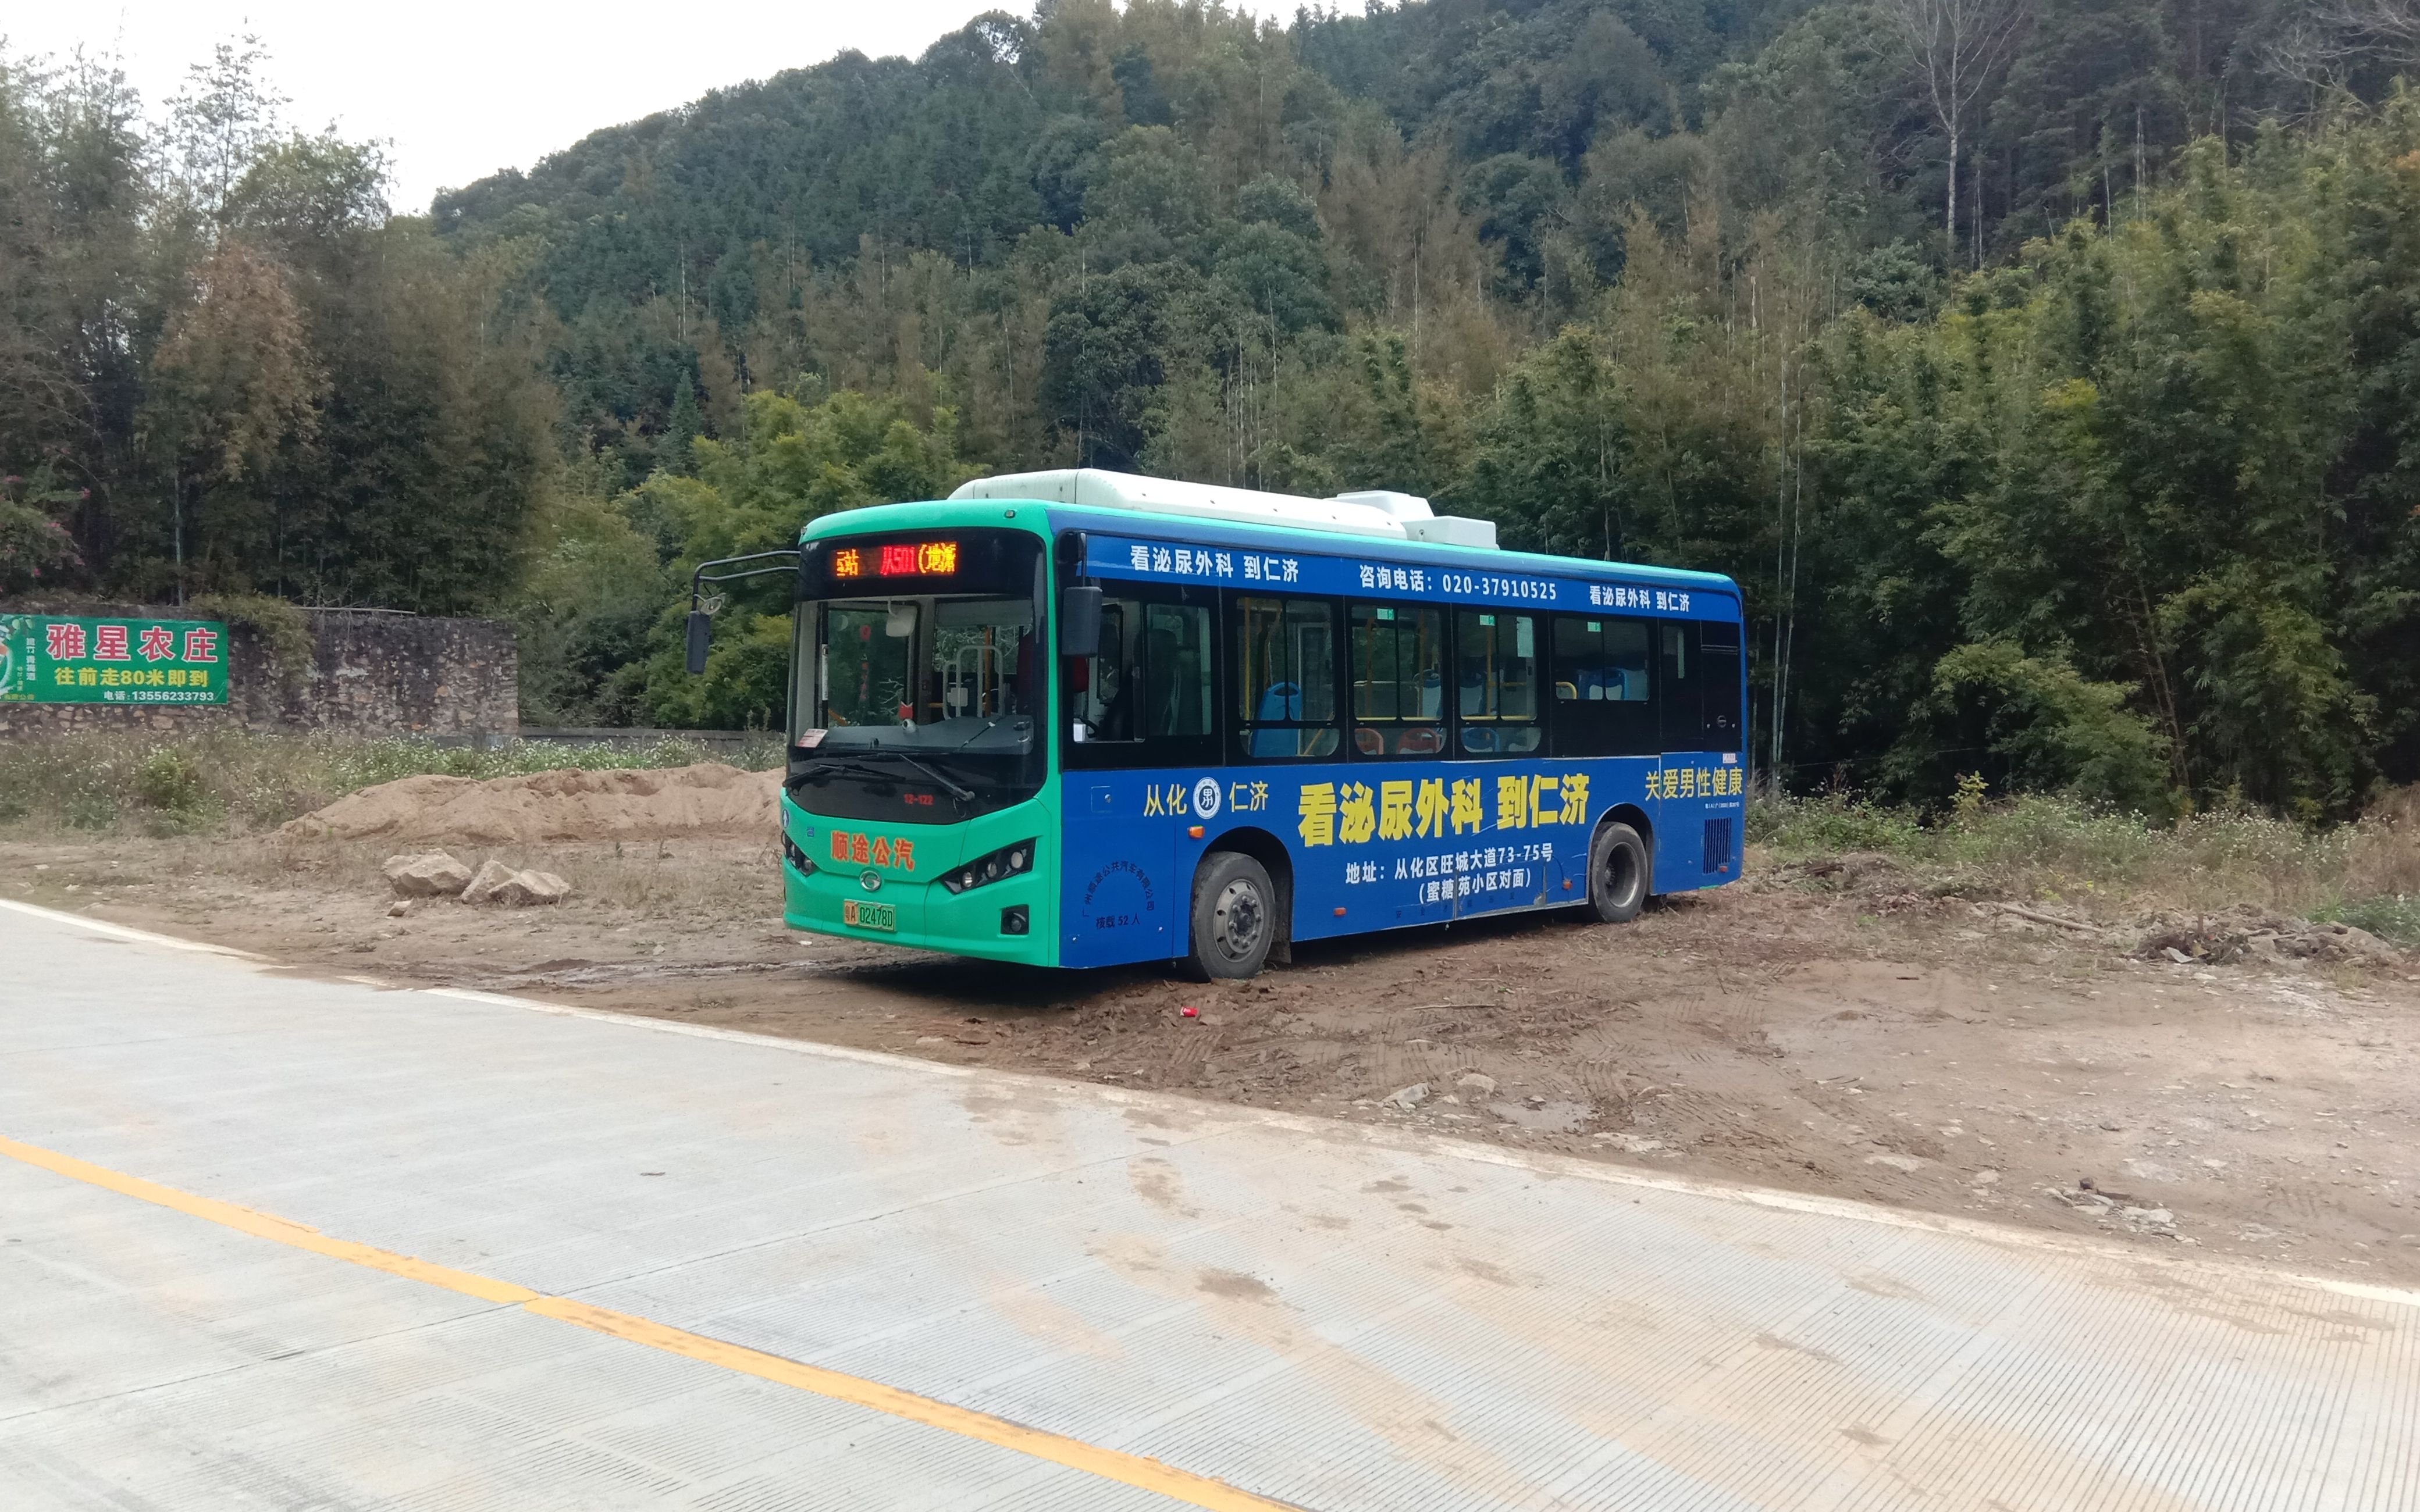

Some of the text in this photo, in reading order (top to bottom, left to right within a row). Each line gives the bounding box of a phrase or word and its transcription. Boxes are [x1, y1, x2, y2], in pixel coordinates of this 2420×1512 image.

[1130, 545, 1298, 583] 看泌尿外科 到仁济
[1590, 585, 1690, 612] 看泌尿外科 到仁济
[47, 623, 218, 663] 雅星农庄
[55, 667, 208, 687] 往前走80米即到
[1144, 783, 1187, 817] 从化
[1229, 780, 1268, 812] 仁济
[1645, 766, 1743, 801] 关爱男性健康
[1298, 773, 1590, 847] 看泌尿外科 到仁济
[831, 830, 916, 871] 顺途公汽
